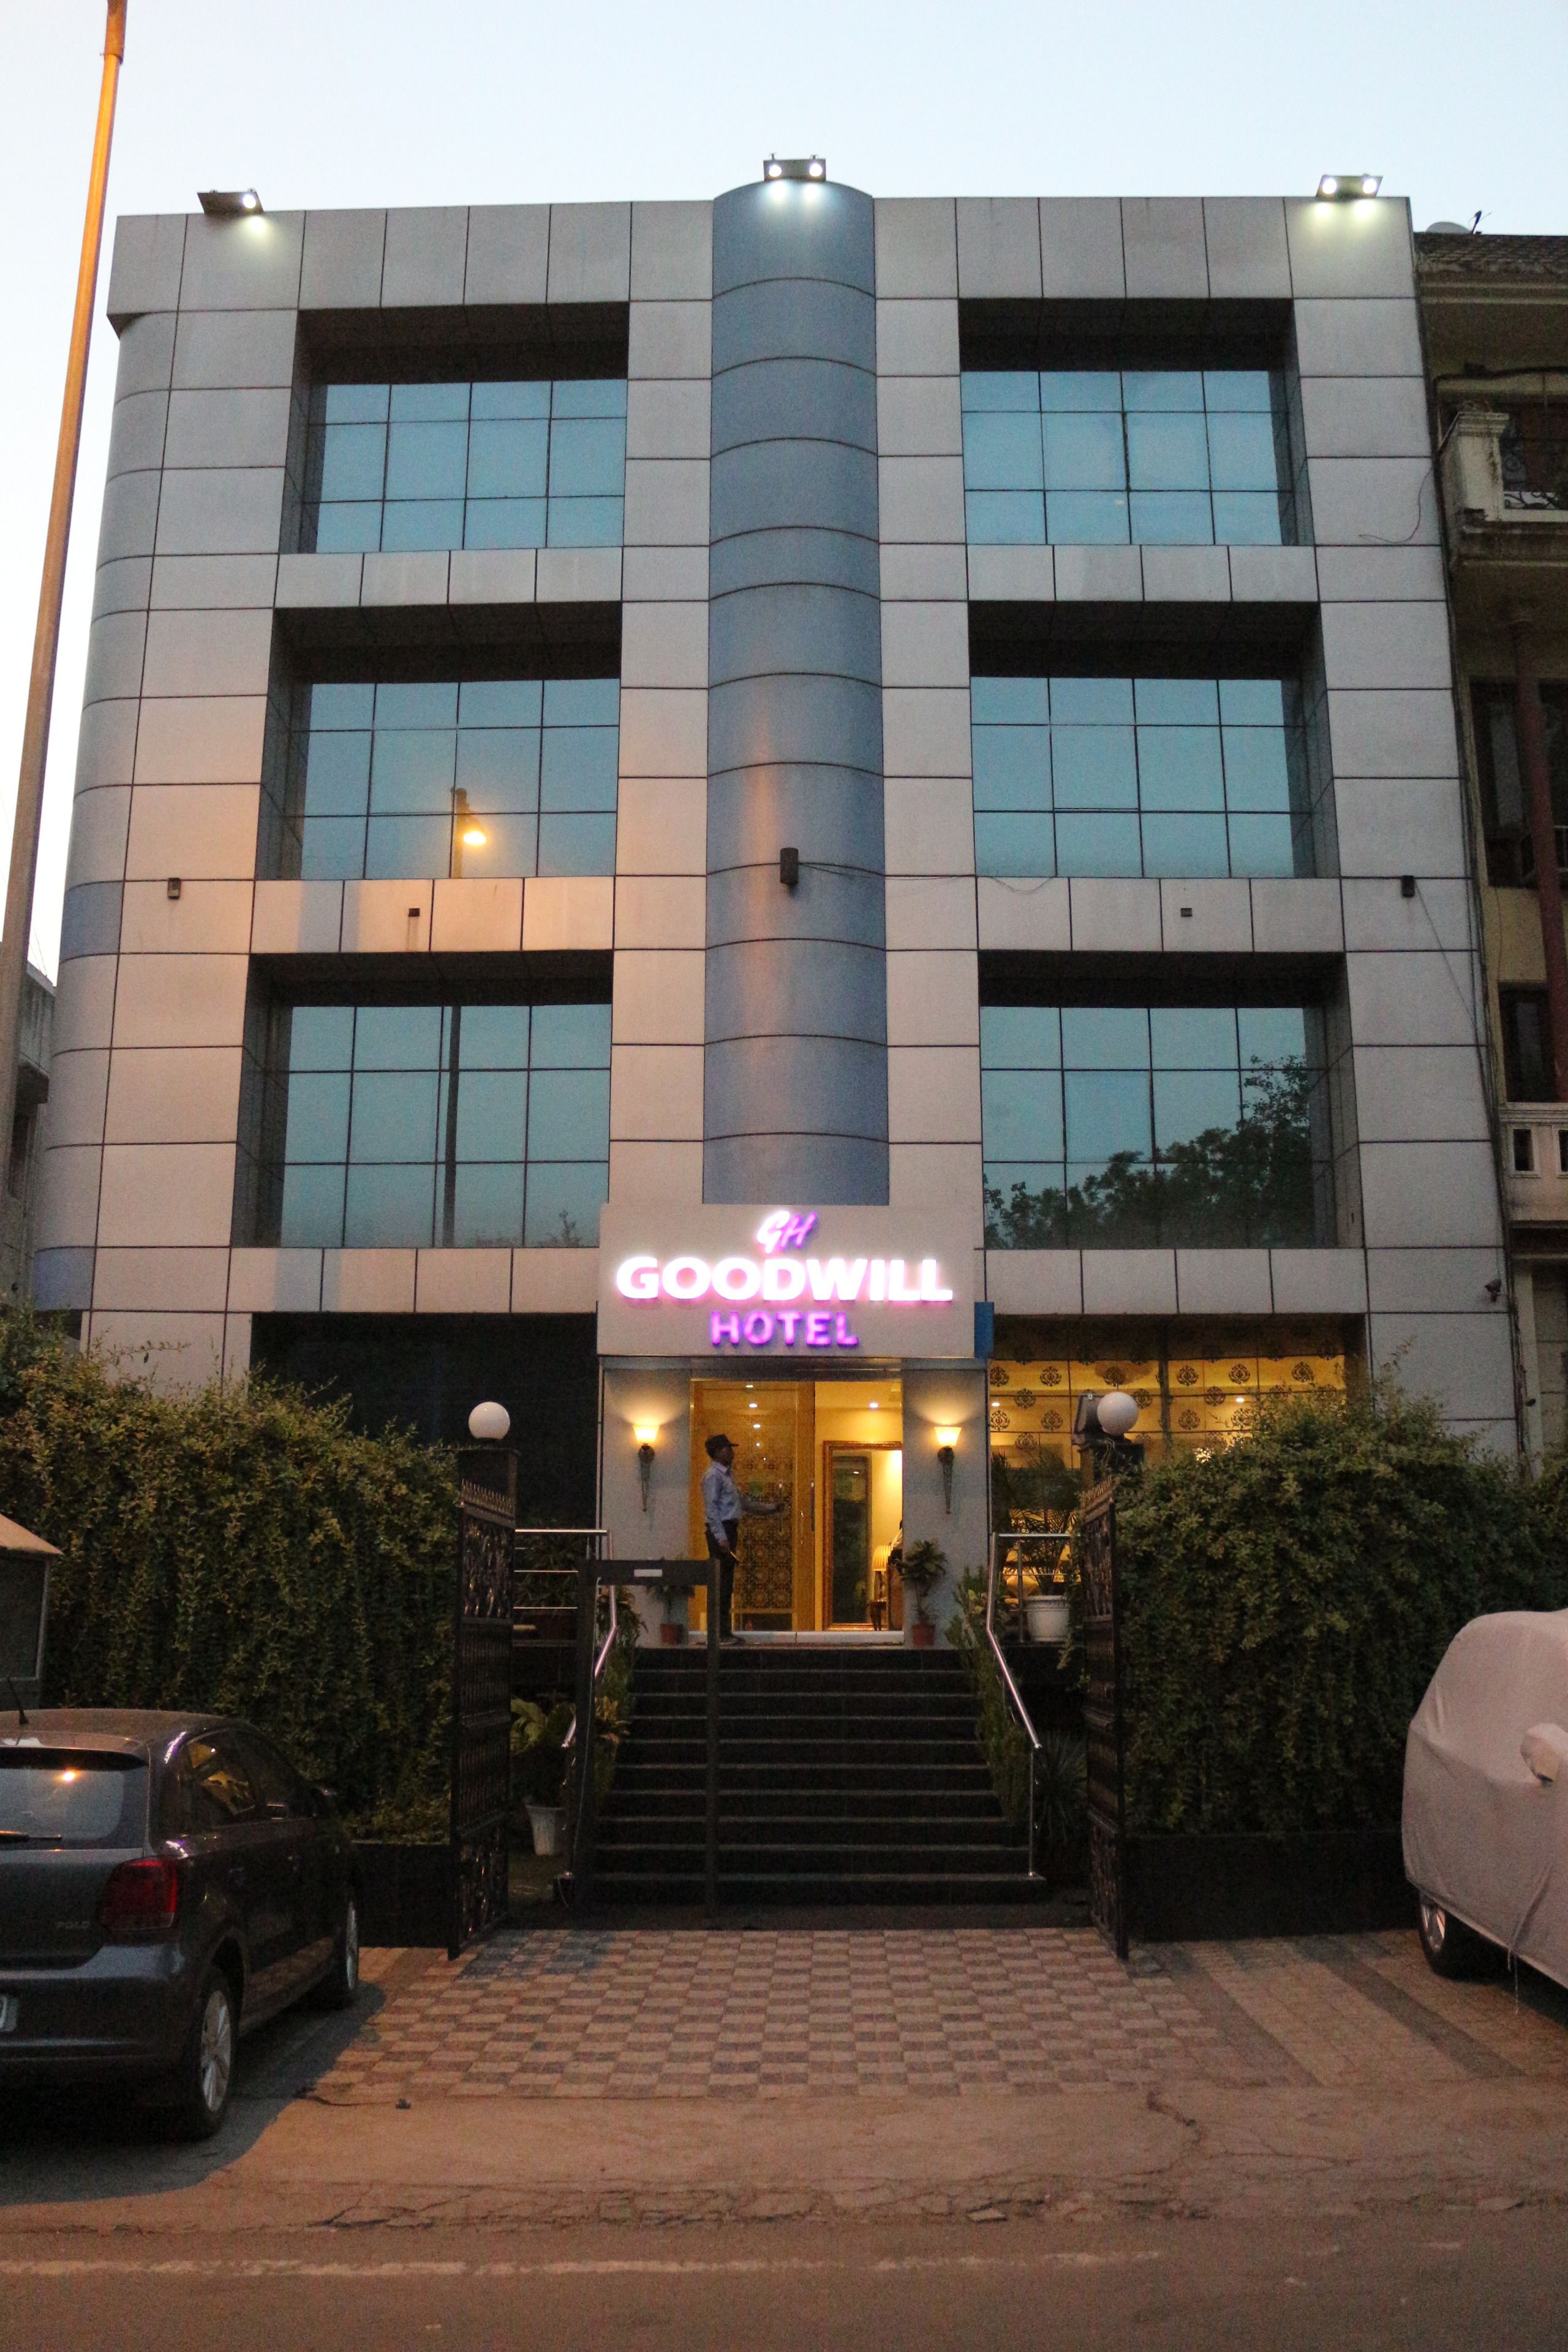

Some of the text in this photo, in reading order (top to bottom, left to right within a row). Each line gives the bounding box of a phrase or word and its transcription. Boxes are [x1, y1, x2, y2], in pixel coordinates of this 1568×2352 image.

[756, 1211, 816, 1253] GH
[616, 1257, 953, 1302] GOODWILL
[710, 1311, 859, 1346] HOTEL
